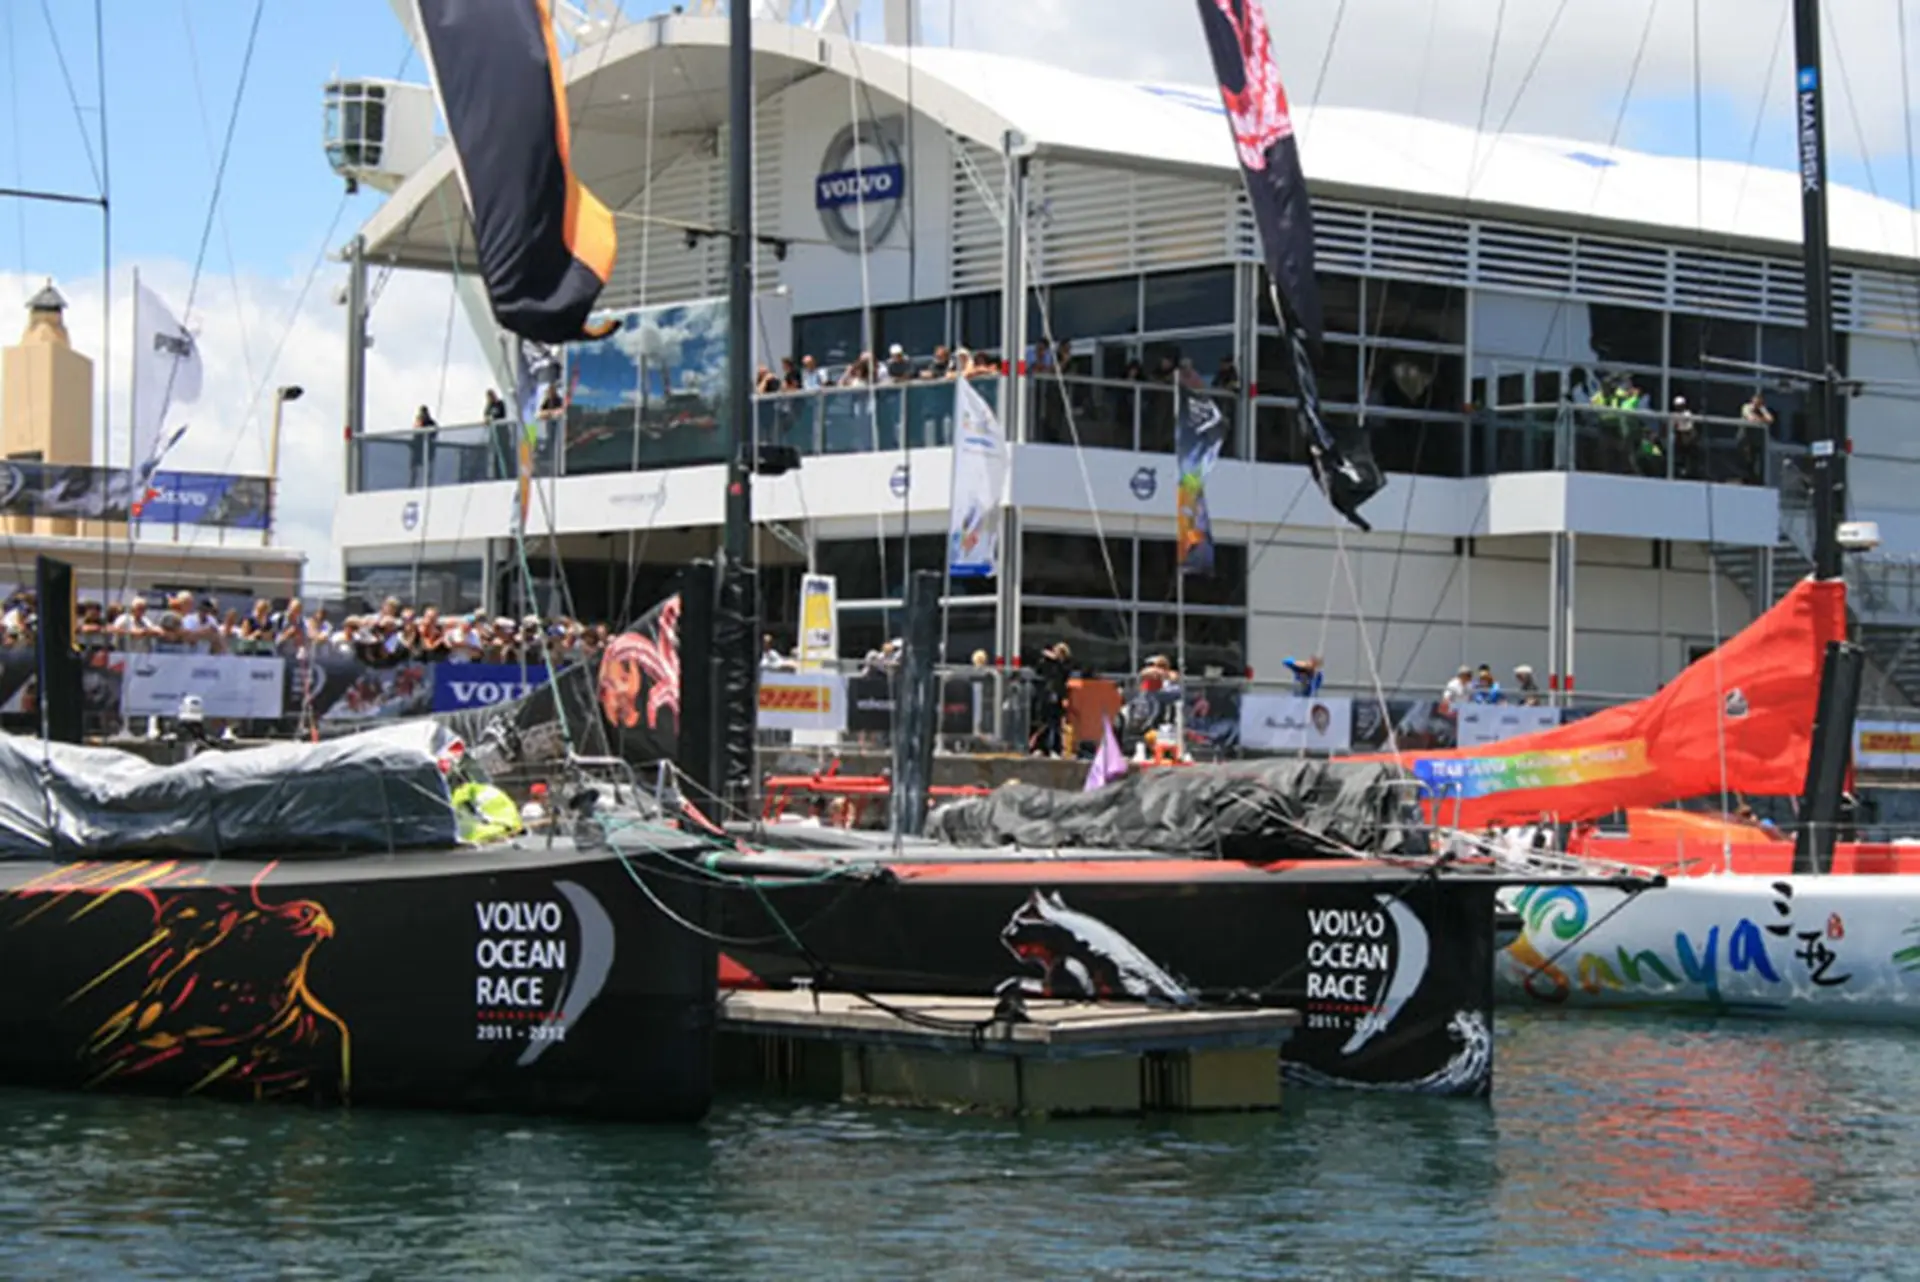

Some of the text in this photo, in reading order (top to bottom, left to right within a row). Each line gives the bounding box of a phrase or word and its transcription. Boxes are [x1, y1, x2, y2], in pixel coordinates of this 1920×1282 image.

[1801, 93, 1819, 192] MAERSK
[821, 174, 893, 199] VOLVO
[475, 901, 562, 932] VOLVO
[1308, 909, 1385, 938] VOLVO
[476, 939, 567, 970] OCEAN
[1307, 942, 1388, 970] OCEAN
[1506, 885, 1781, 1005] Sanya
[476, 976, 543, 1006] RACE
[1307, 973, 1367, 1001] RACE
[477, 1025, 513, 1040] 2011
